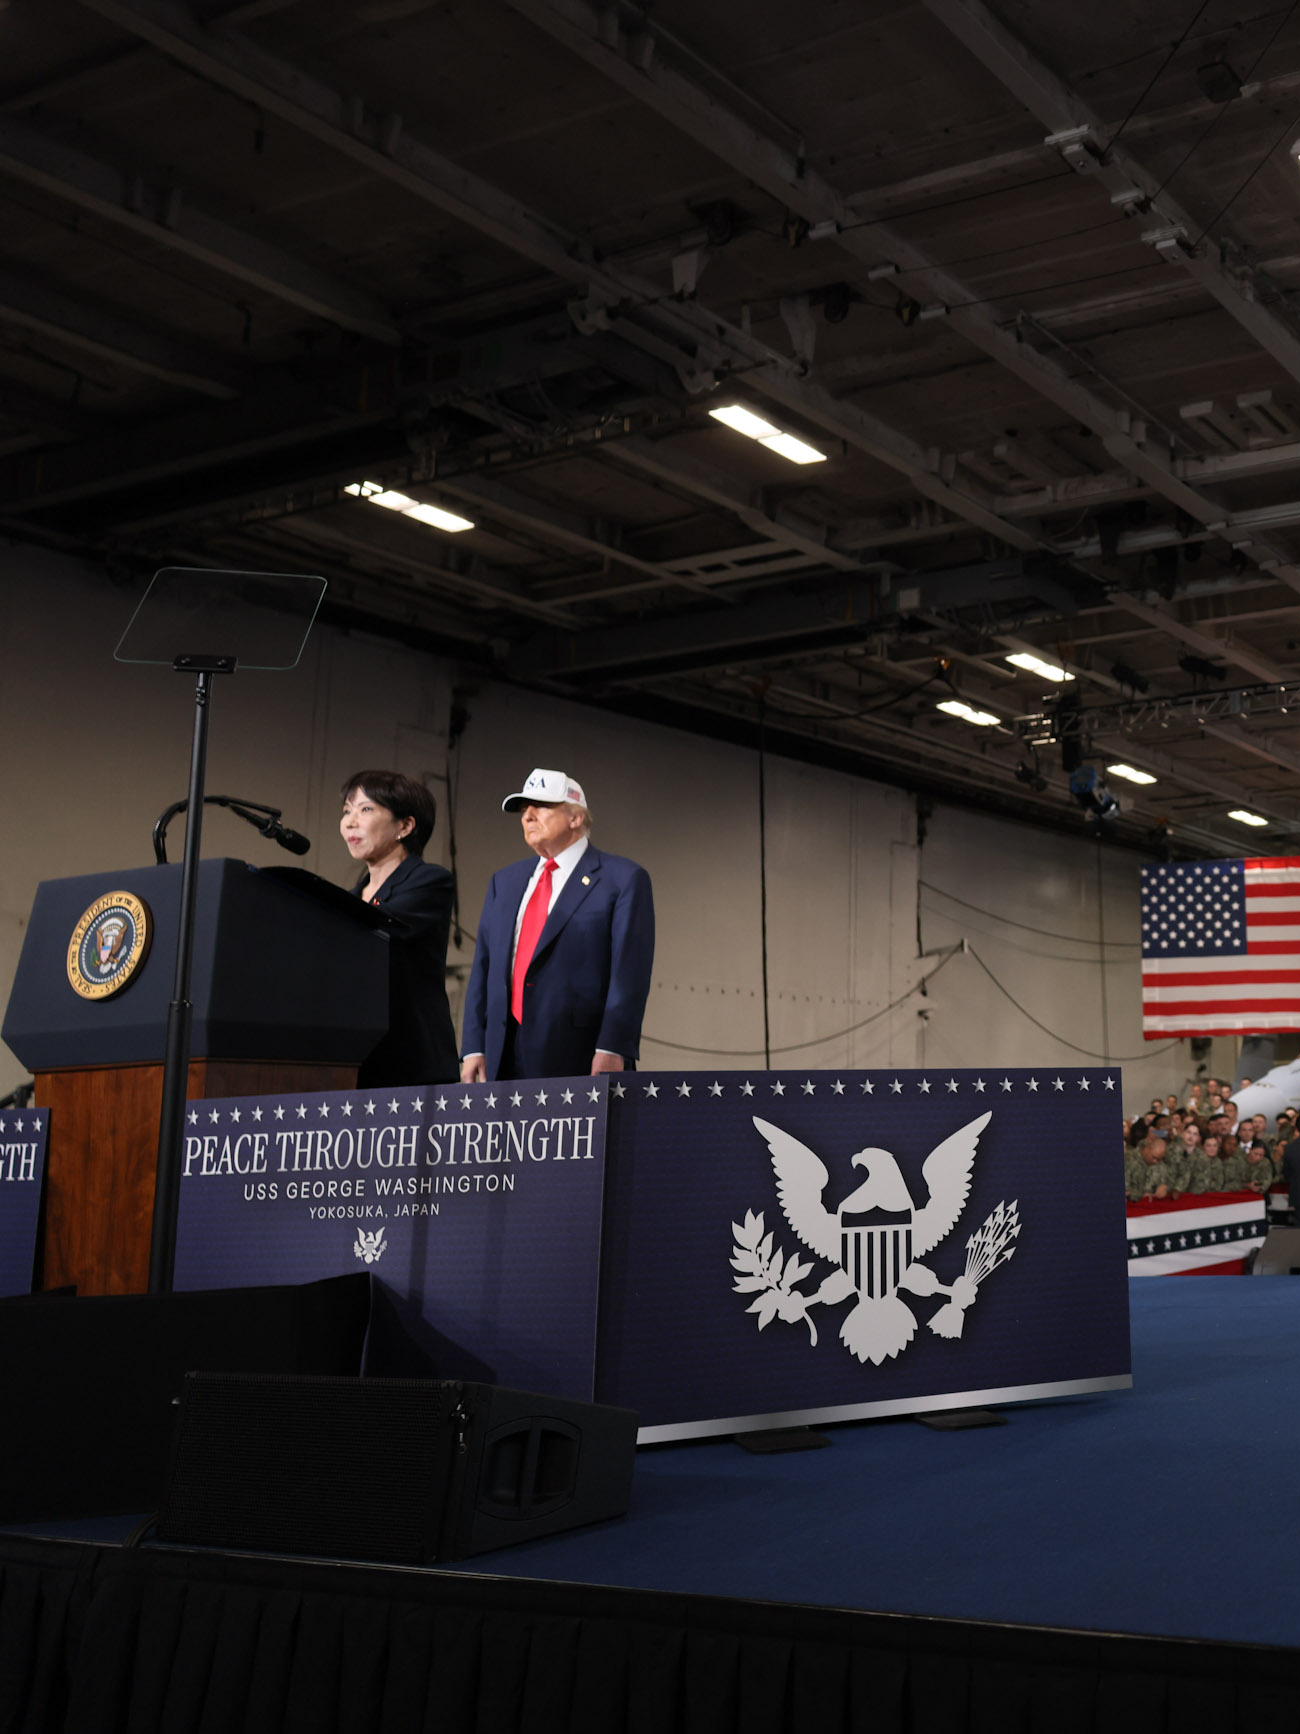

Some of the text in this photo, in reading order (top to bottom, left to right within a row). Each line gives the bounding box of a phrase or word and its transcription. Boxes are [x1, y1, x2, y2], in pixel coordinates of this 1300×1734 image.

[72, 896, 114, 946] PRESIDENT
[132, 904, 144, 947] UNITED
[105, 959, 136, 993] STATES
[0, 1142, 38, 1181] TH
[182, 1116, 597, 1177] PEACE THROUGH STRENGTH
[243, 1173, 515, 1201] USS GEORGE WASHINGTON
[309, 1202, 440, 1220] YOKOSUKA, JAPAN
